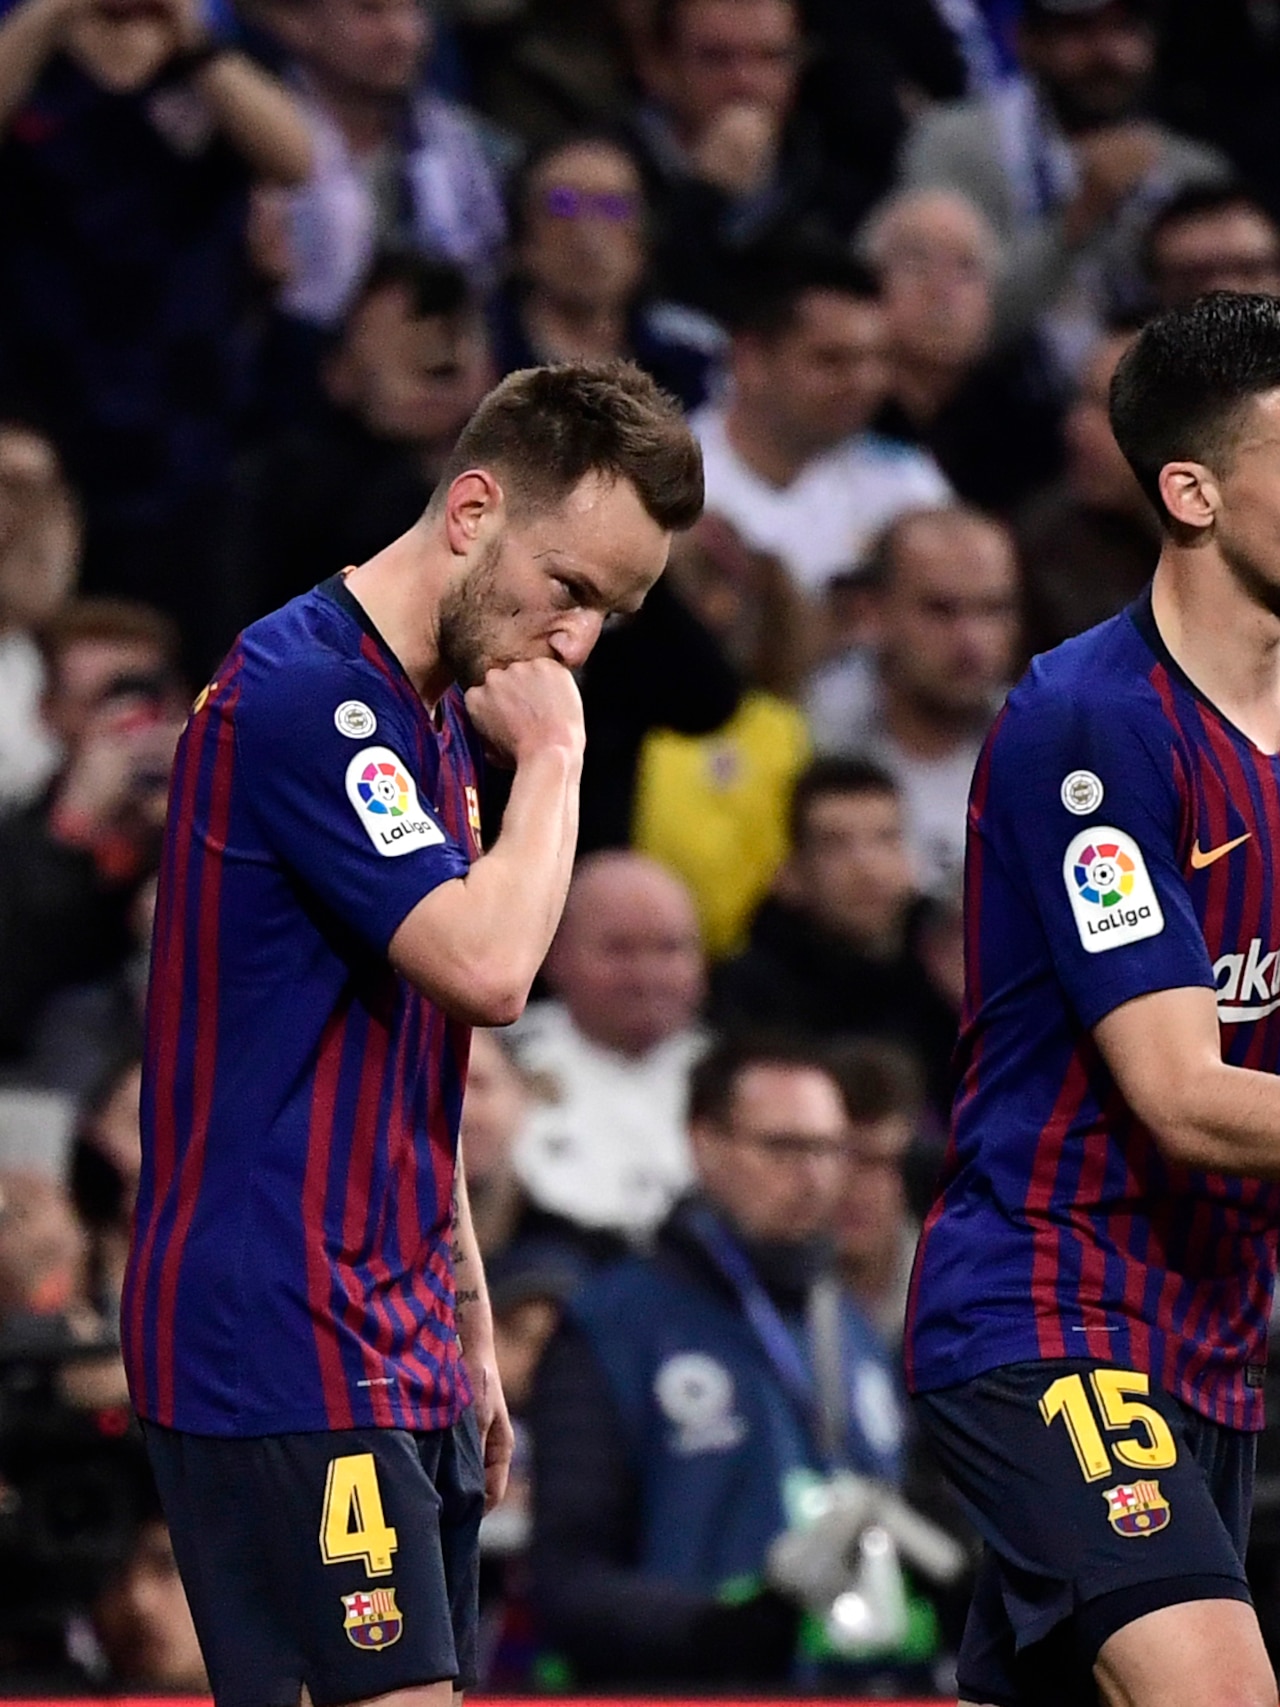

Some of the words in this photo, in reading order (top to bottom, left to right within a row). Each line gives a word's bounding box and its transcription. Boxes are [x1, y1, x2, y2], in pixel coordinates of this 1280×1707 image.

[380, 820, 432, 845] LaLiga
[1087, 906, 1151, 935] LaLiga
[1038, 1369, 1177, 1484] 15
[319, 1453, 399, 1578] 4
